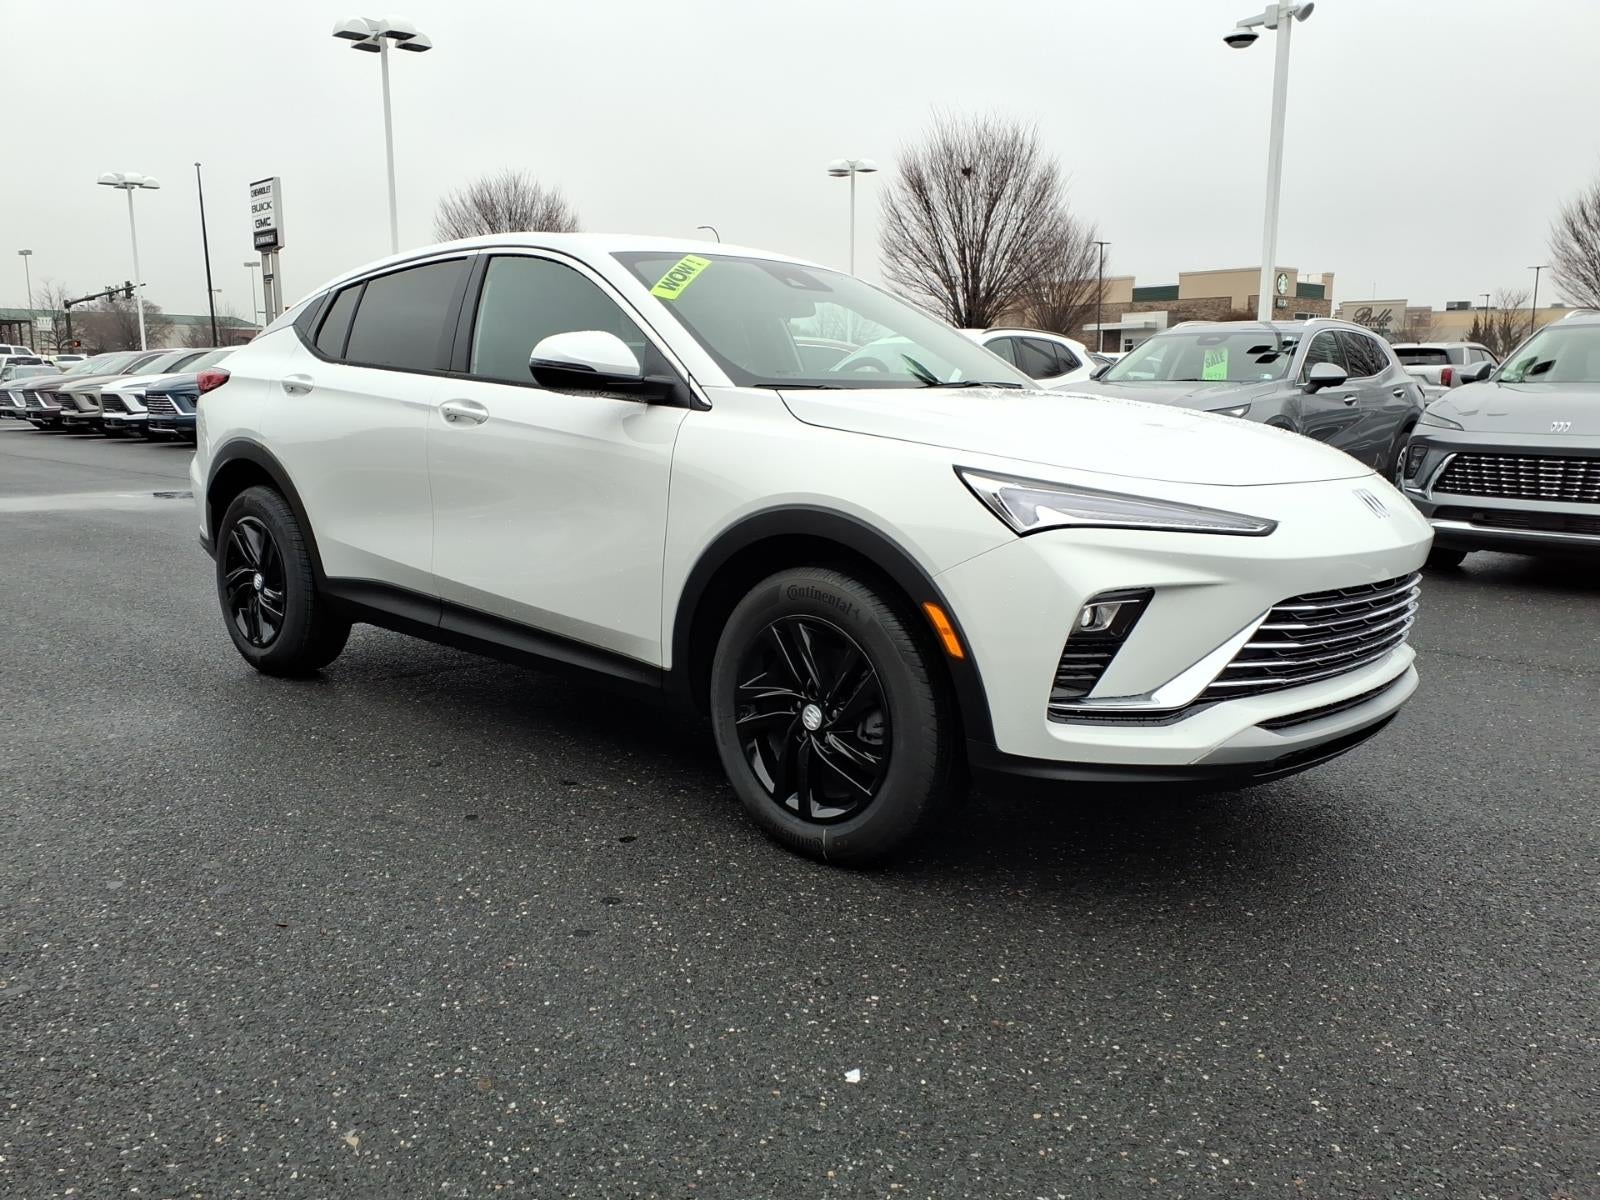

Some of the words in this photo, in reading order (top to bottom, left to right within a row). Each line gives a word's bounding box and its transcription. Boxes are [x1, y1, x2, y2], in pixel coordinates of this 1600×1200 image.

[251, 201, 272, 214] BUICK
[255, 216, 271, 228] GMC
[1352, 306, 1393, 324] Belle
[1205, 351, 1226, 368] SALE
[787, 584, 853, 615] Continental
